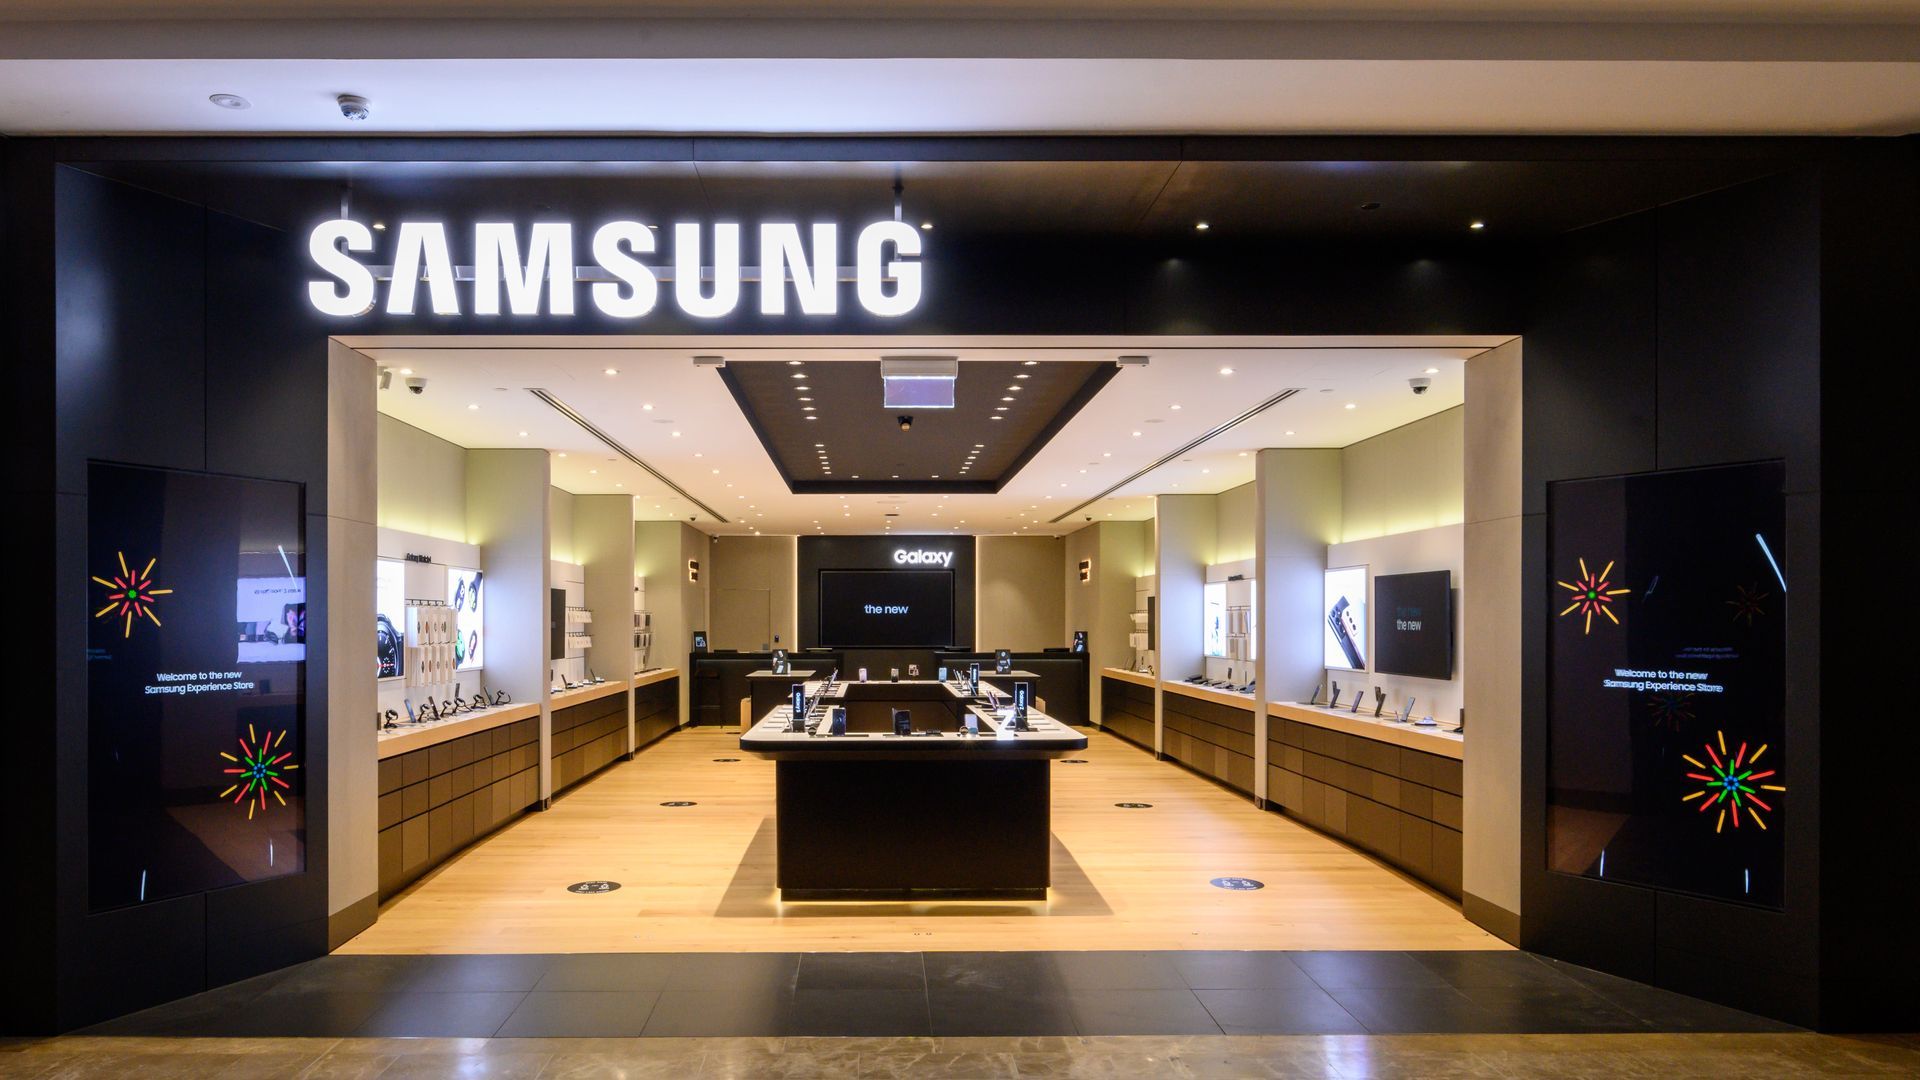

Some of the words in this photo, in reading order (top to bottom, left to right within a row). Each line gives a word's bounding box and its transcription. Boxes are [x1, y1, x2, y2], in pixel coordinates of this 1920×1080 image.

[308, 219, 922, 316] SAMSUNG
[893, 549, 953, 568] Galaxy
[864, 605, 882, 614] the
[884, 606, 909, 614] new
[1407, 620, 1422, 631] new
[156, 672, 197, 682] Welcome
[199, 671, 207, 680] to
[209, 671, 223, 680] the
[224, 671, 242, 679] new
[1614, 668, 1656, 679] Welcome
[1658, 670, 1667, 679] to
[1669, 670, 1685, 680] the
[1686, 672, 1708, 680] new
[144, 684, 186, 695] Samsung
[187, 682, 232, 694] Experience
[233, 681, 254, 690] Store
[1603, 679, 1645, 691] Samsung
[1645, 681, 1696, 692] Experience
[1697, 683, 1724, 693] Store
